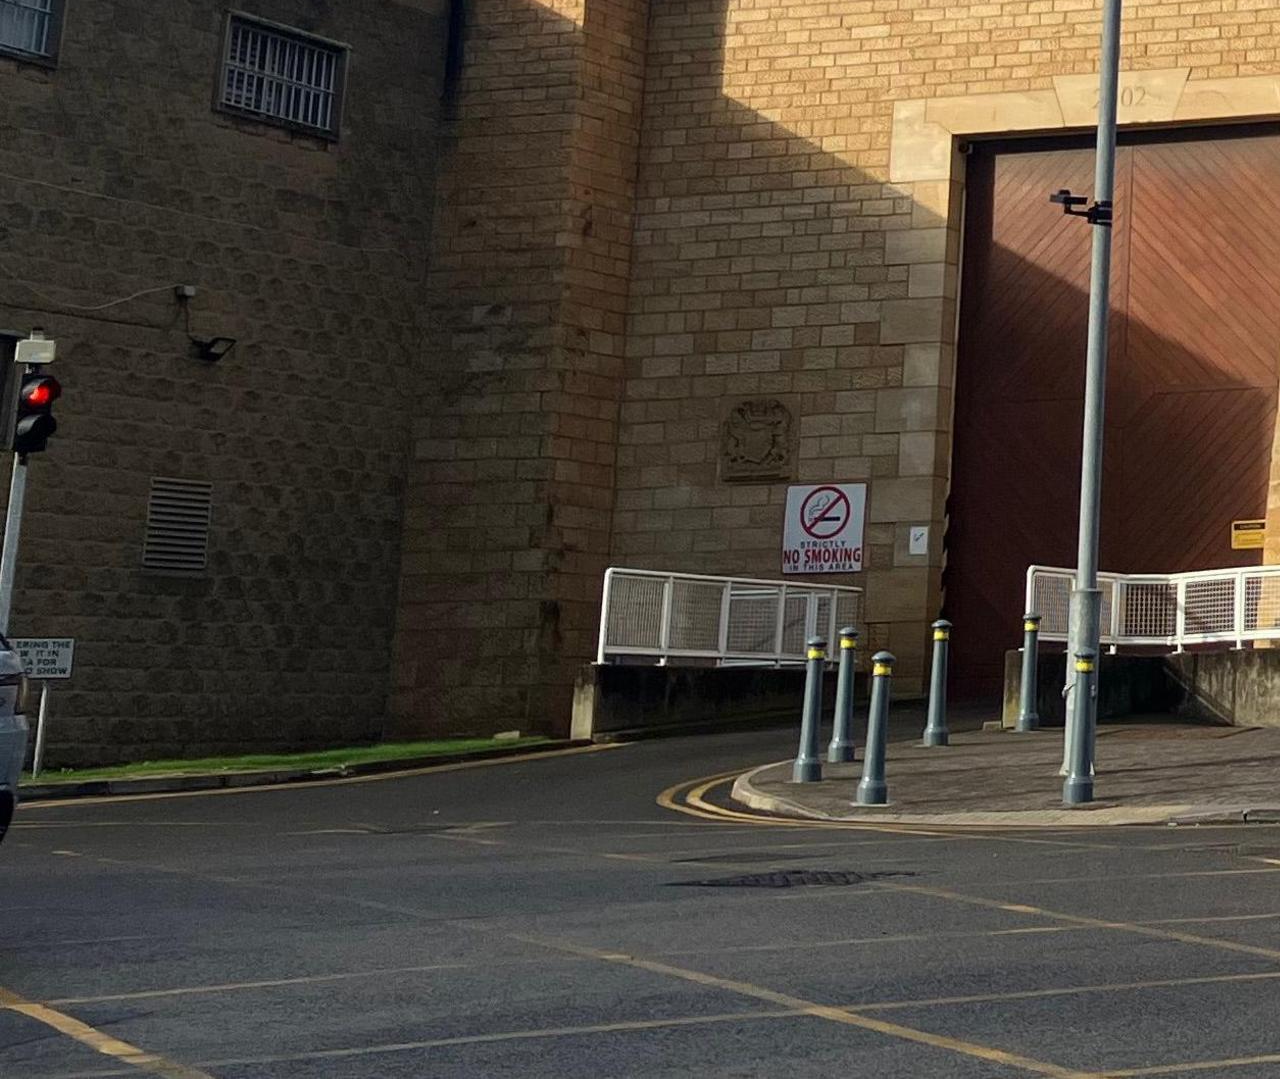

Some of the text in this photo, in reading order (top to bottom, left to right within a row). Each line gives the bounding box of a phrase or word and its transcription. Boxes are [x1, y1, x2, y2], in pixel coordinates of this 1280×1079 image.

[801, 541, 846, 549] STRICTLY
[783, 548, 861, 564] NO SMOKING
